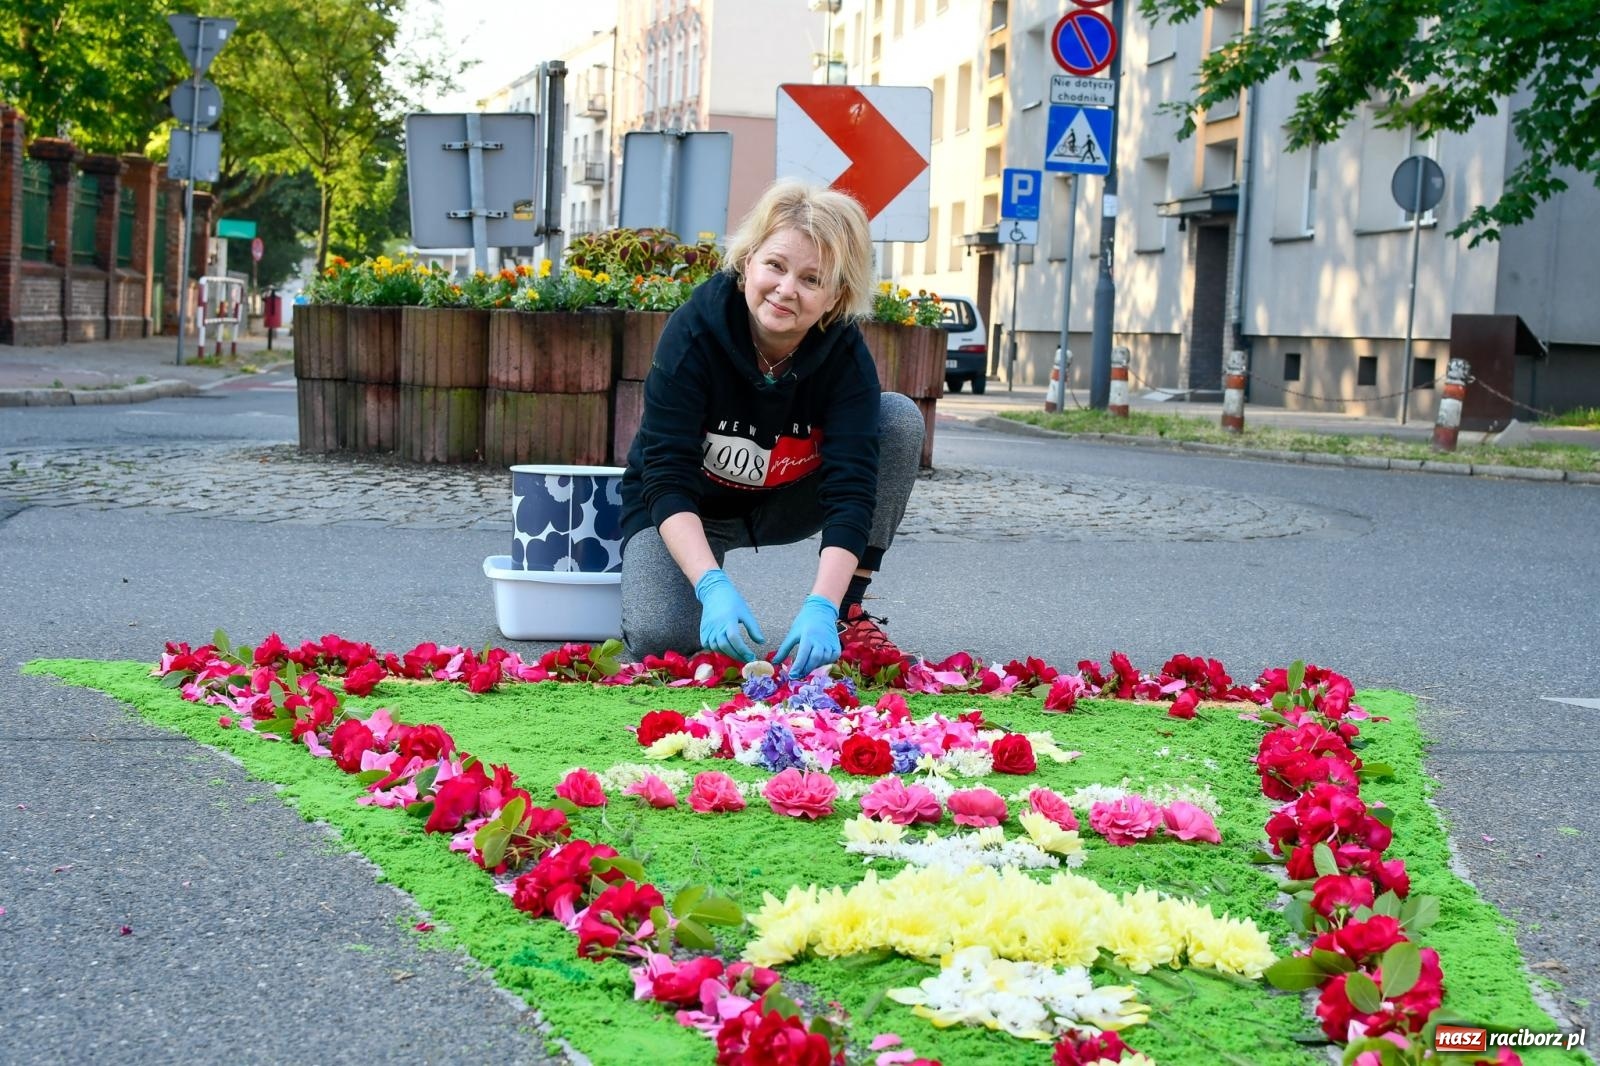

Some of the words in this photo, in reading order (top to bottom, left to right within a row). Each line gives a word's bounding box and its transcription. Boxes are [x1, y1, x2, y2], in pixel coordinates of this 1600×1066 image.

[1054, 78, 1071, 87] Nie
[1075, 80, 1113, 91] dotyczy
[1058, 92, 1106, 102] chodnika
[1011, 173, 1034, 205] P
[718, 420, 757, 437] NEW
[703, 440, 765, 481] 1998
